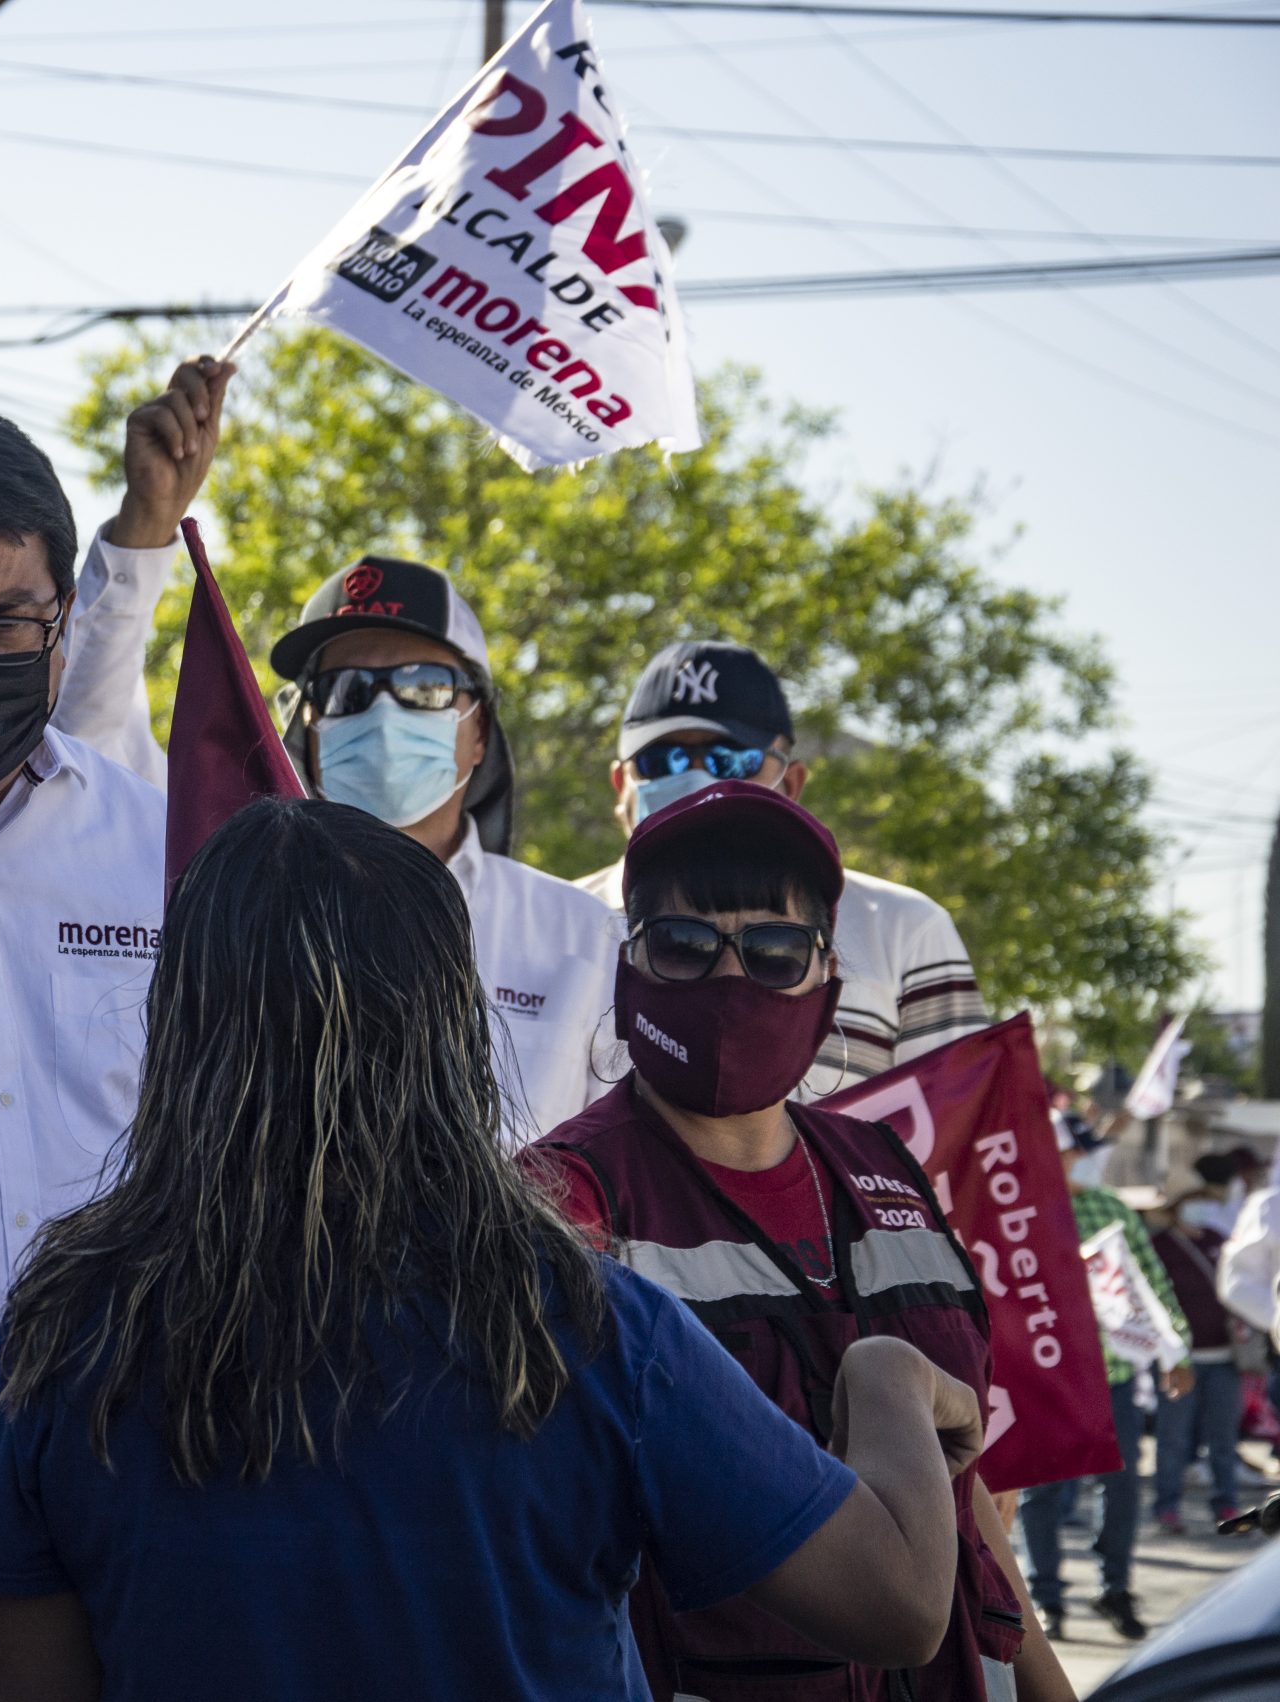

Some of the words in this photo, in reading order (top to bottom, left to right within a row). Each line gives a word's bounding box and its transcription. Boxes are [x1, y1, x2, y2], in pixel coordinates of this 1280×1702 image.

[343, 255, 404, 293] JUNIO
[365, 240, 418, 279] VOTA
[422, 265, 632, 428] morena
[402, 299, 426, 321] La
[426, 316, 511, 373] esperanza
[509, 369, 535, 391] de
[534, 385, 600, 442] México
[58, 944, 69, 954] La
[71, 947, 120, 957] esperanza
[122, 949, 133, 958] de
[59, 922, 161, 948] morena
[636, 1012, 689, 1064] morena
[875, 1208, 927, 1228] 2020
[975, 1129, 1063, 1369] Roberto
